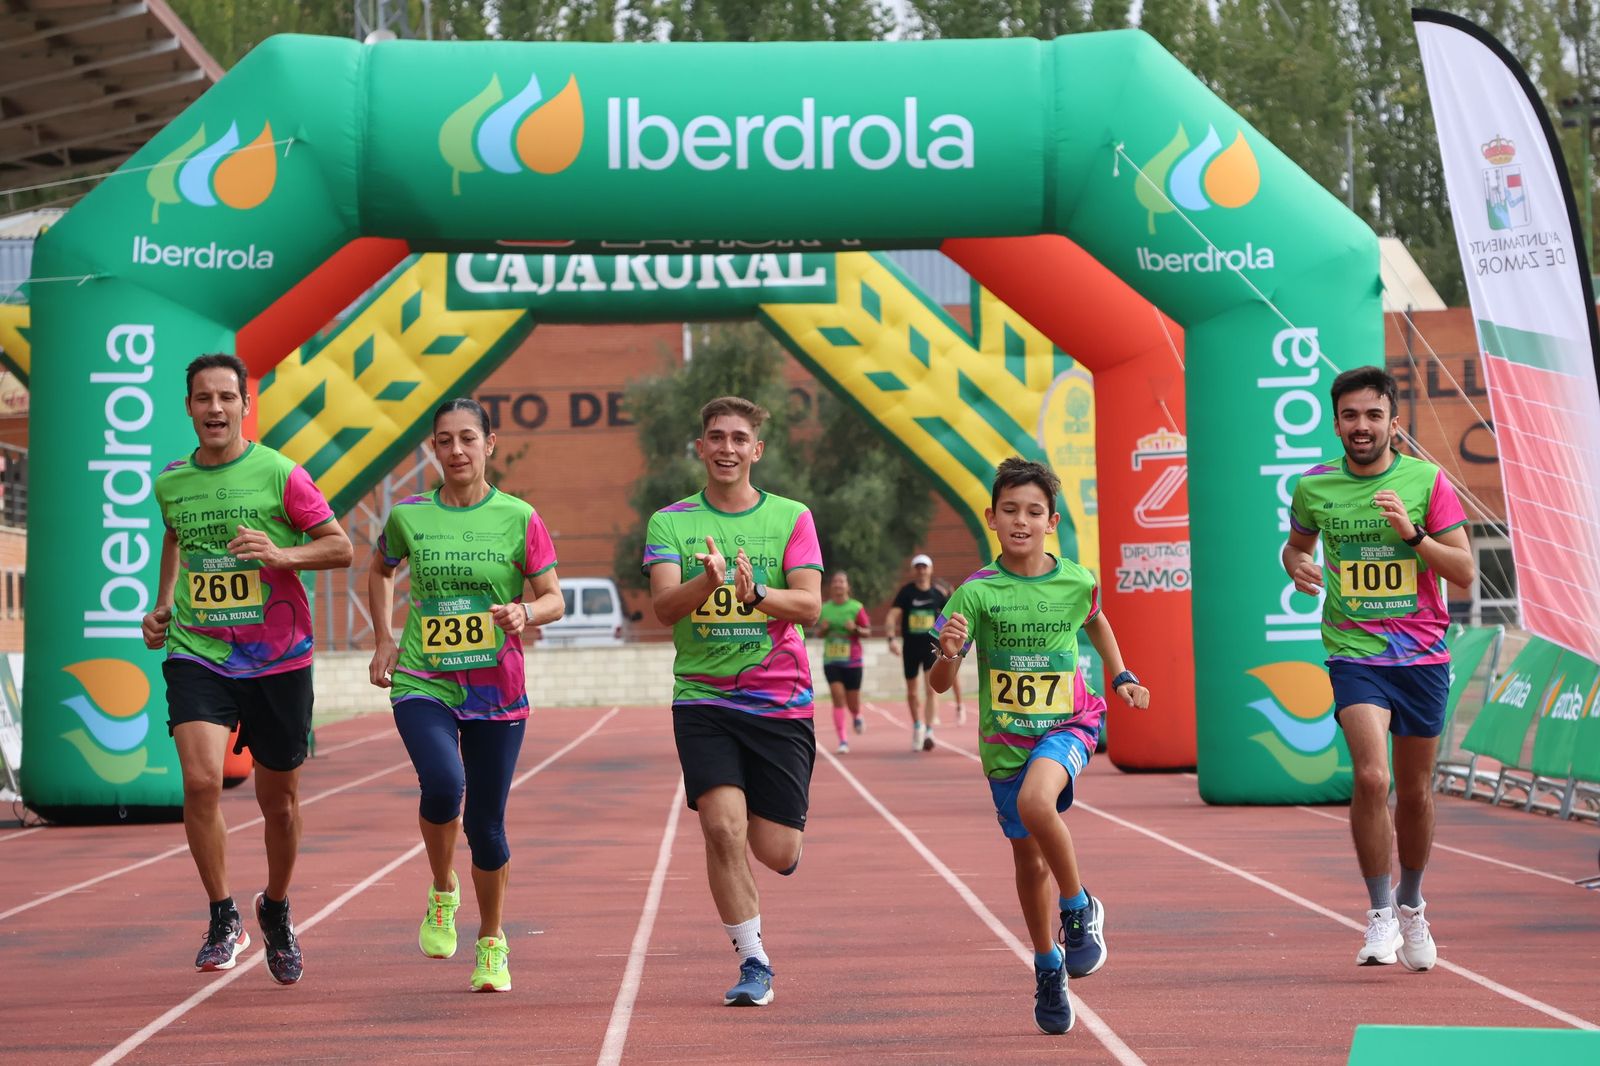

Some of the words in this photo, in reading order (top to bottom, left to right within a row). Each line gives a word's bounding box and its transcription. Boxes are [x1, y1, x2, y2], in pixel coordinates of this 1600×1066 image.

[608, 97, 974, 170] Iberdrola
[132, 235, 274, 270] Iberdrola
[1136, 242, 1275, 274] Iberdrola
[83, 323, 155, 639] Iberdrola
[181, 510, 197, 524] En
[201, 505, 259, 521] marcha
[181, 523, 228, 540] contra
[1332, 517, 1350, 530] En
[1333, 531, 1381, 544] contra
[422, 548, 440, 562] En
[445, 548, 506, 564] marcha
[421, 563, 473, 577] contra
[1346, 562, 1403, 591] 100
[193, 573, 249, 603] 260
[425, 579, 438, 592] el
[441, 578, 495, 592] cáncer
[1385, 599, 1414, 609] RURAL
[230, 610, 260, 620] RURAL
[426, 615, 484, 648] 238
[733, 627, 763, 636] RURAL
[1000, 621, 1017, 633] En
[1021, 620, 1072, 633] marcha
[1000, 636, 1047, 648] contra
[464, 653, 493, 664] RURAL
[996, 672, 1061, 707] 267
